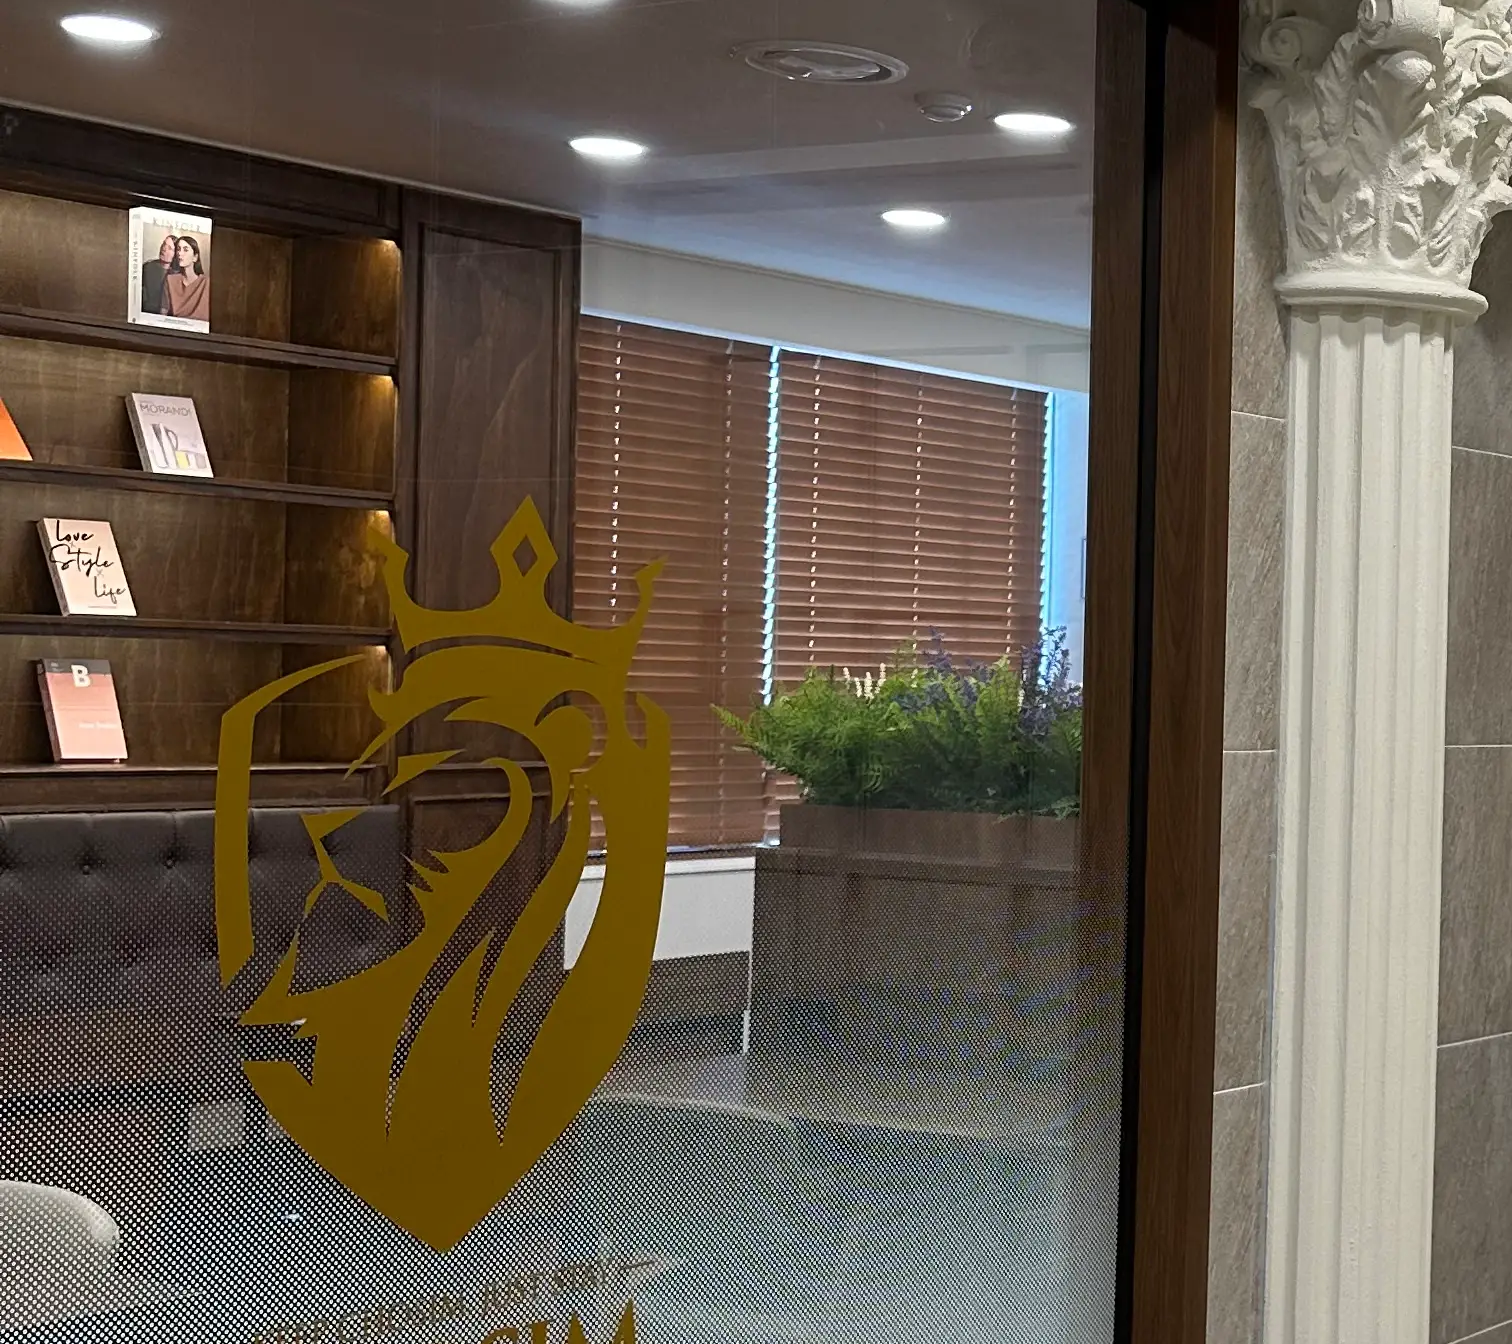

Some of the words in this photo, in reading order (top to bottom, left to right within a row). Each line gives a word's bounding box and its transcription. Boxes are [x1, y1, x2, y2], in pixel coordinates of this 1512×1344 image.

[56, 520, 94, 541] Love
[49, 544, 114, 577] Style
[94, 576, 126, 604] Life
[71, 664, 91, 688] B
